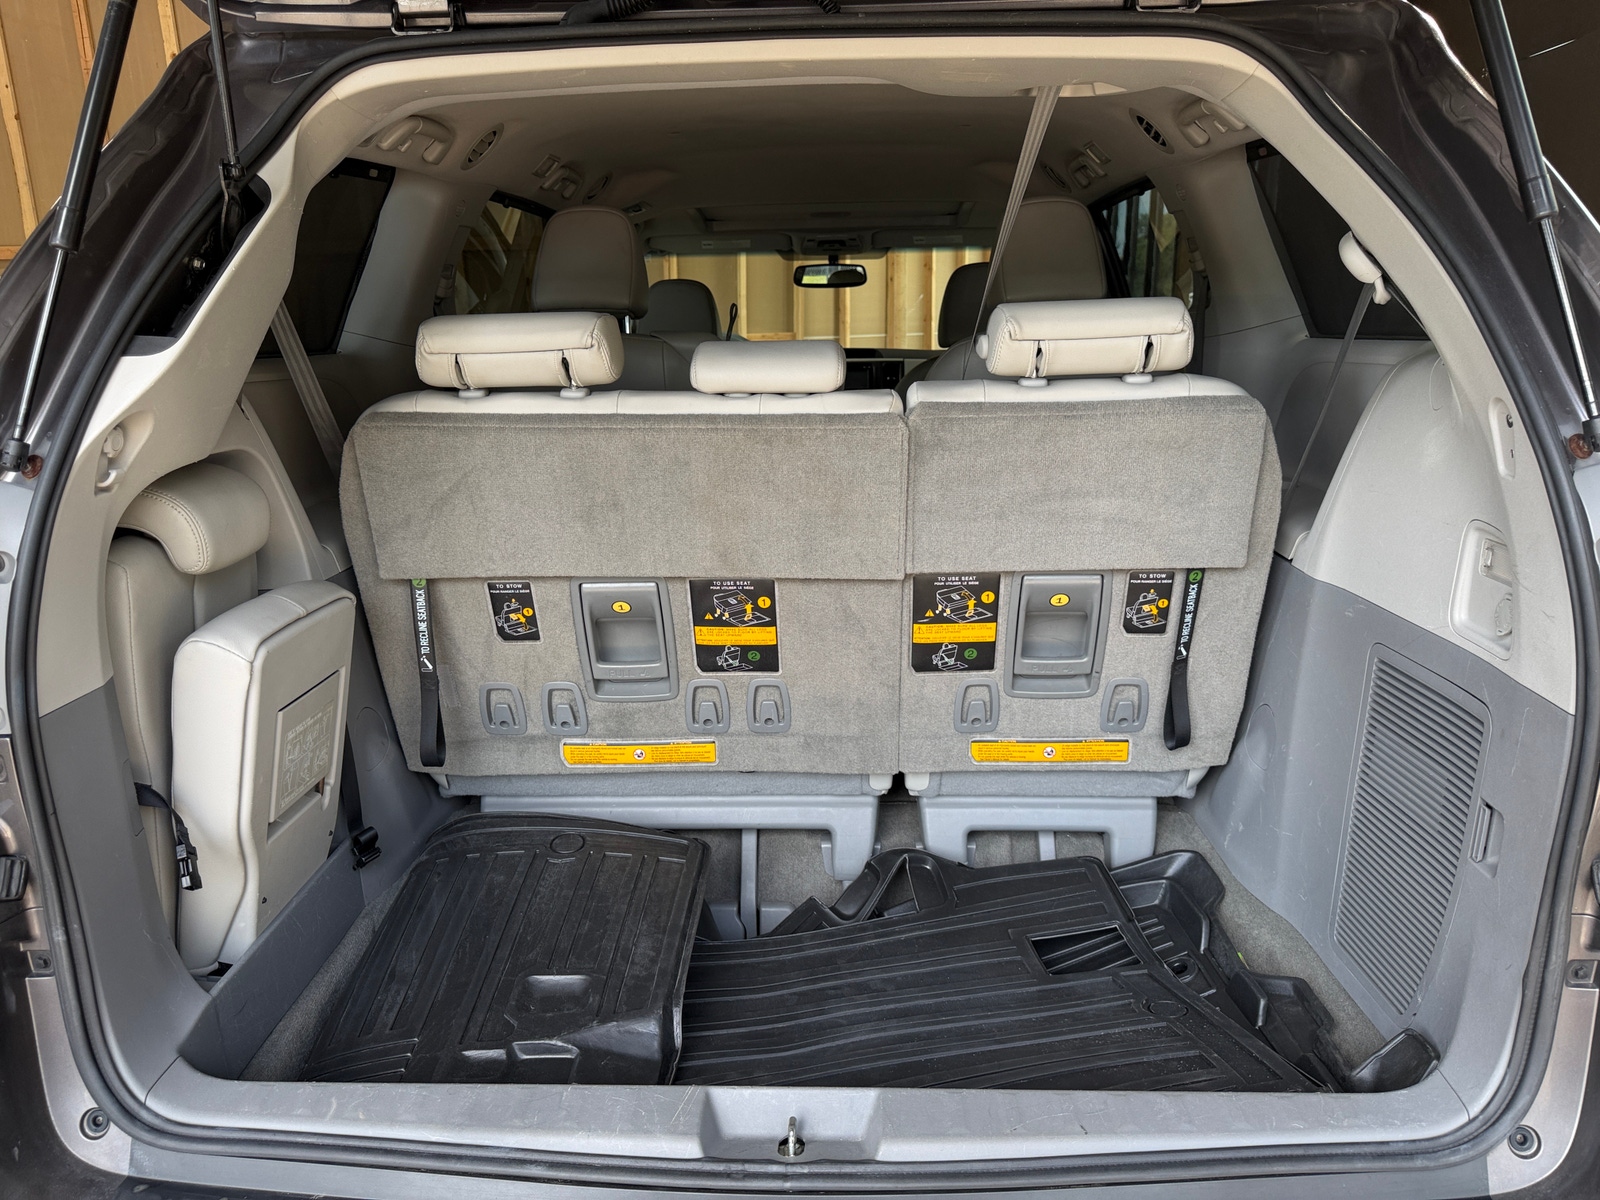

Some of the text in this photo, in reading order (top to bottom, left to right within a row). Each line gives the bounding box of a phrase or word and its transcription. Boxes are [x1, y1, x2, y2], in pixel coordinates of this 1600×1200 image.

[416, 589, 430, 654] TO RECLINE SEATBACK
[1180, 584, 1198, 644] TO RECLINE SEATBACK
